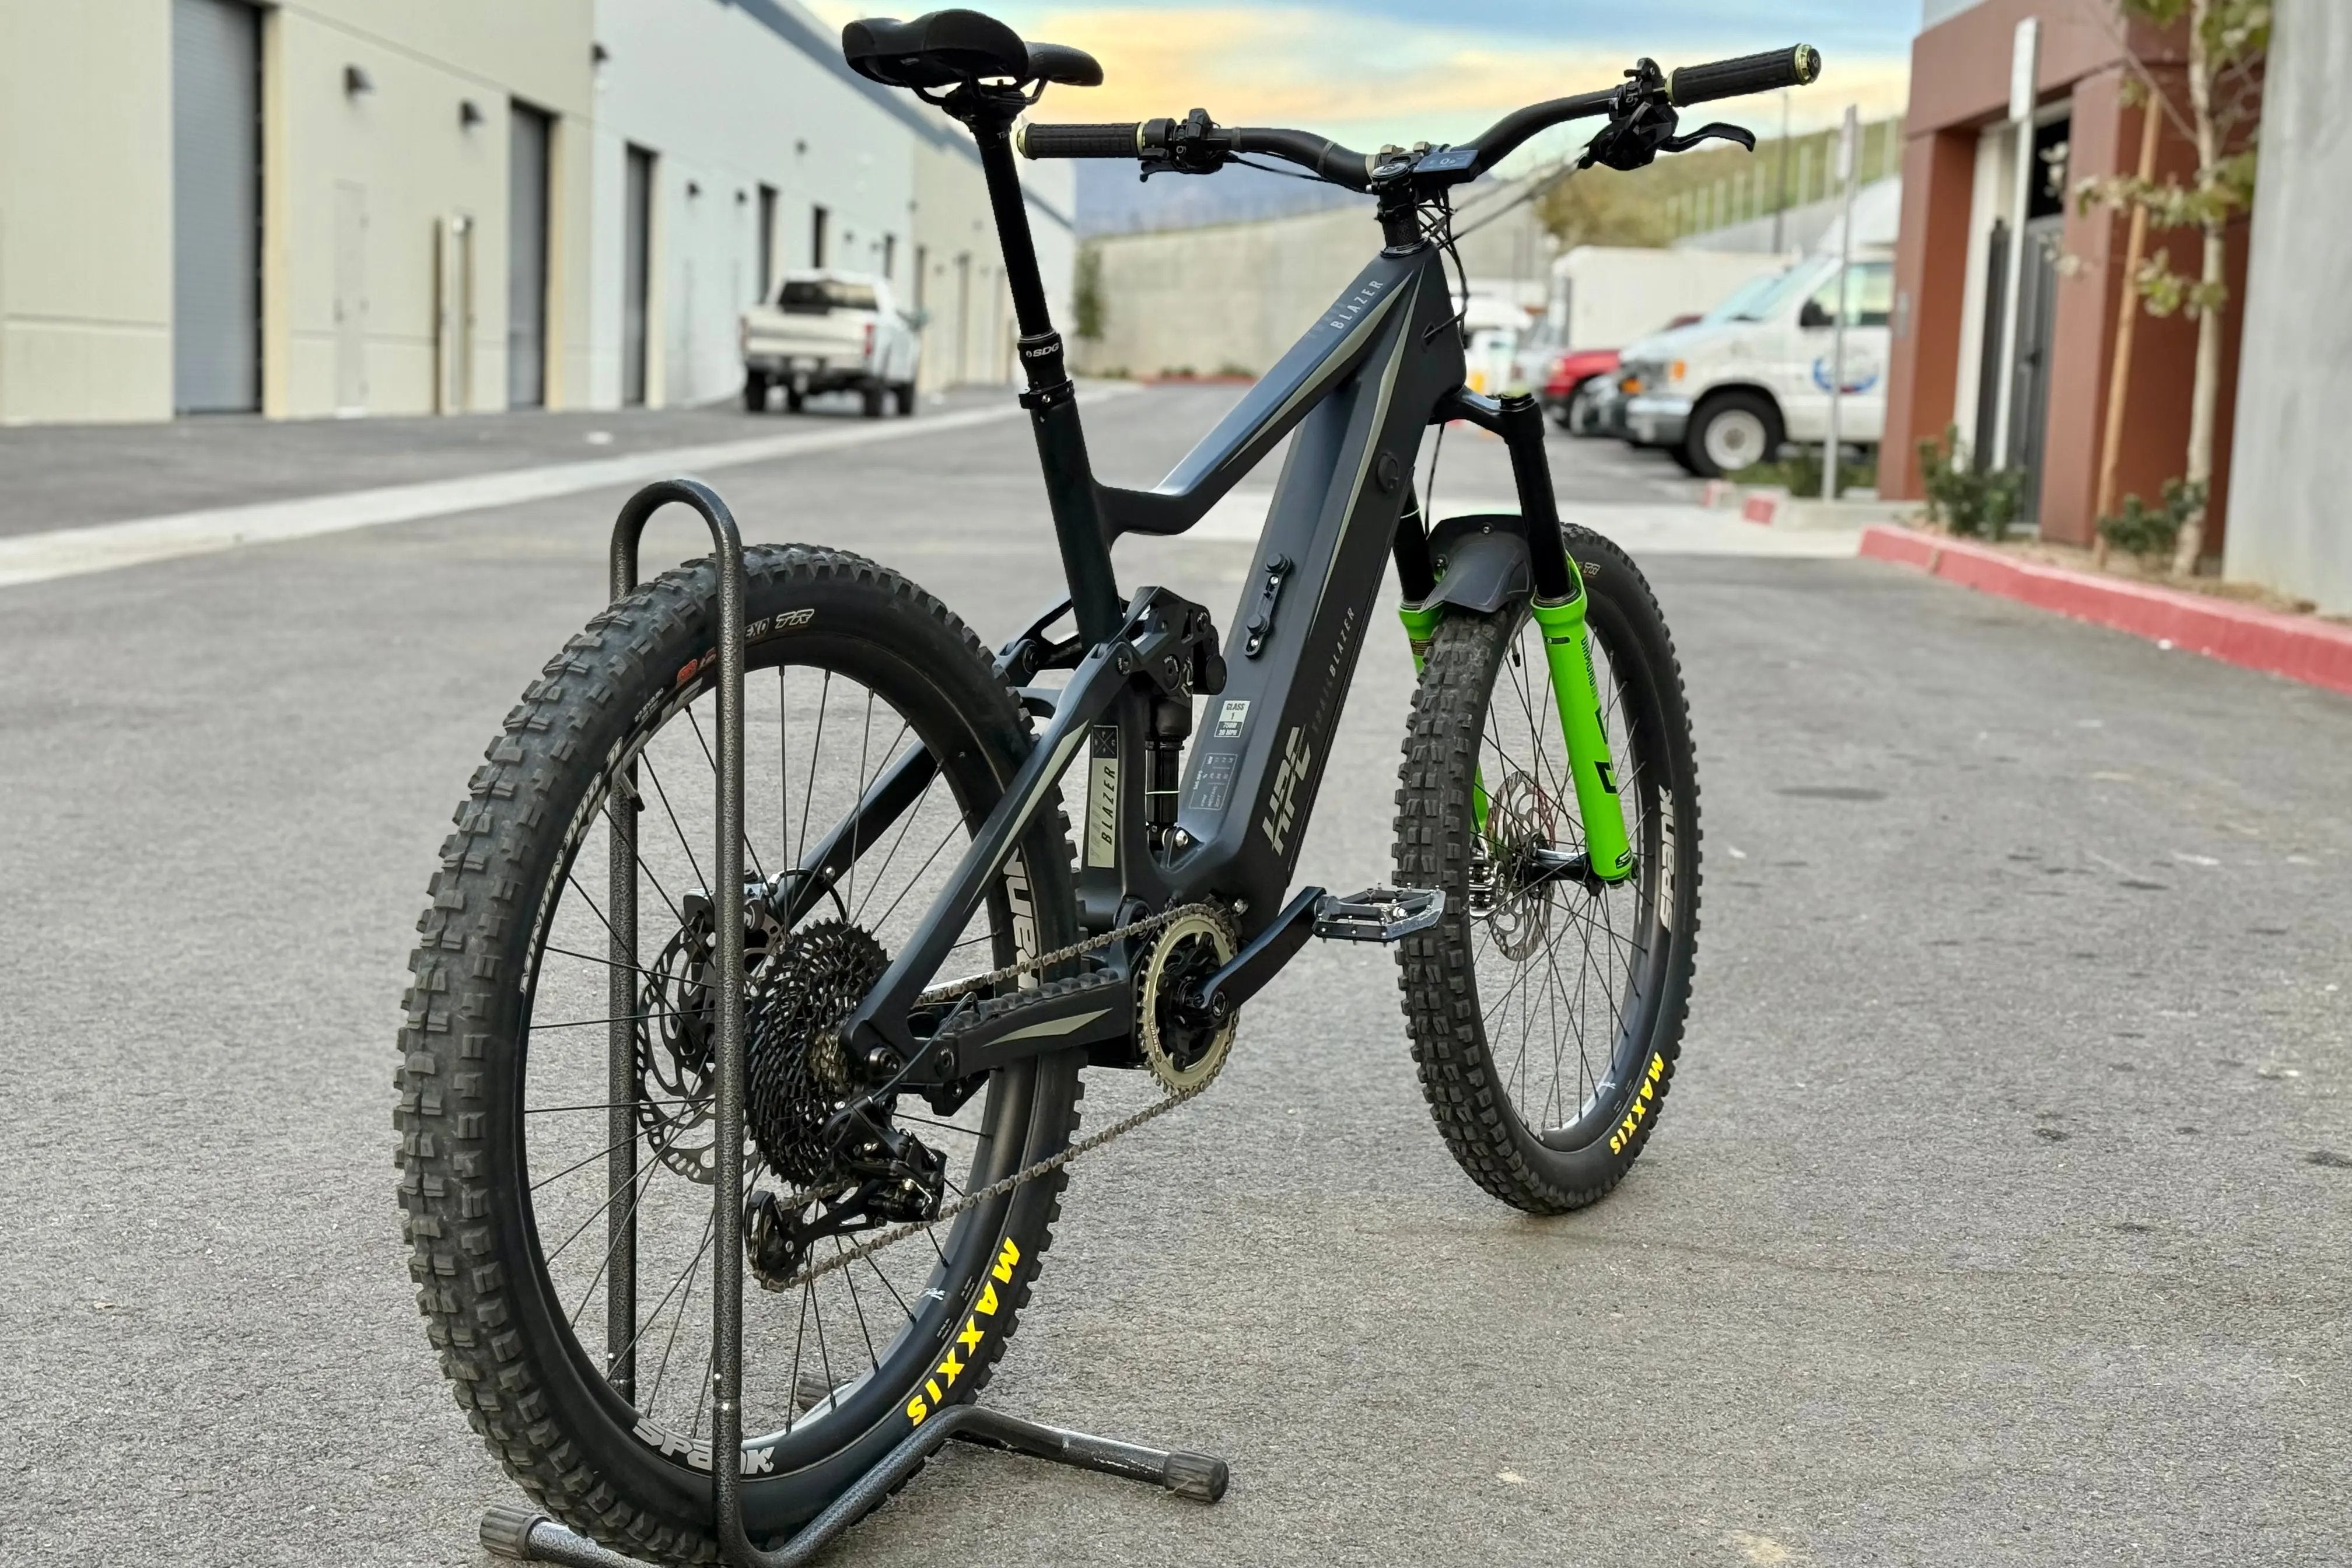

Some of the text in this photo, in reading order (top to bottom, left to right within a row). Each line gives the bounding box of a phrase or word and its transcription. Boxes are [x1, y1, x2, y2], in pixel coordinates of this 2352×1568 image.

[1330, 280, 1383, 329] BLAZER
[1033, 342, 1059, 357] SDG
[1101, 765, 1115, 846] BLAZER
[1609, 1052, 1664, 1155] MAXXIS
[907, 1237, 1020, 1426] MAXXIS
